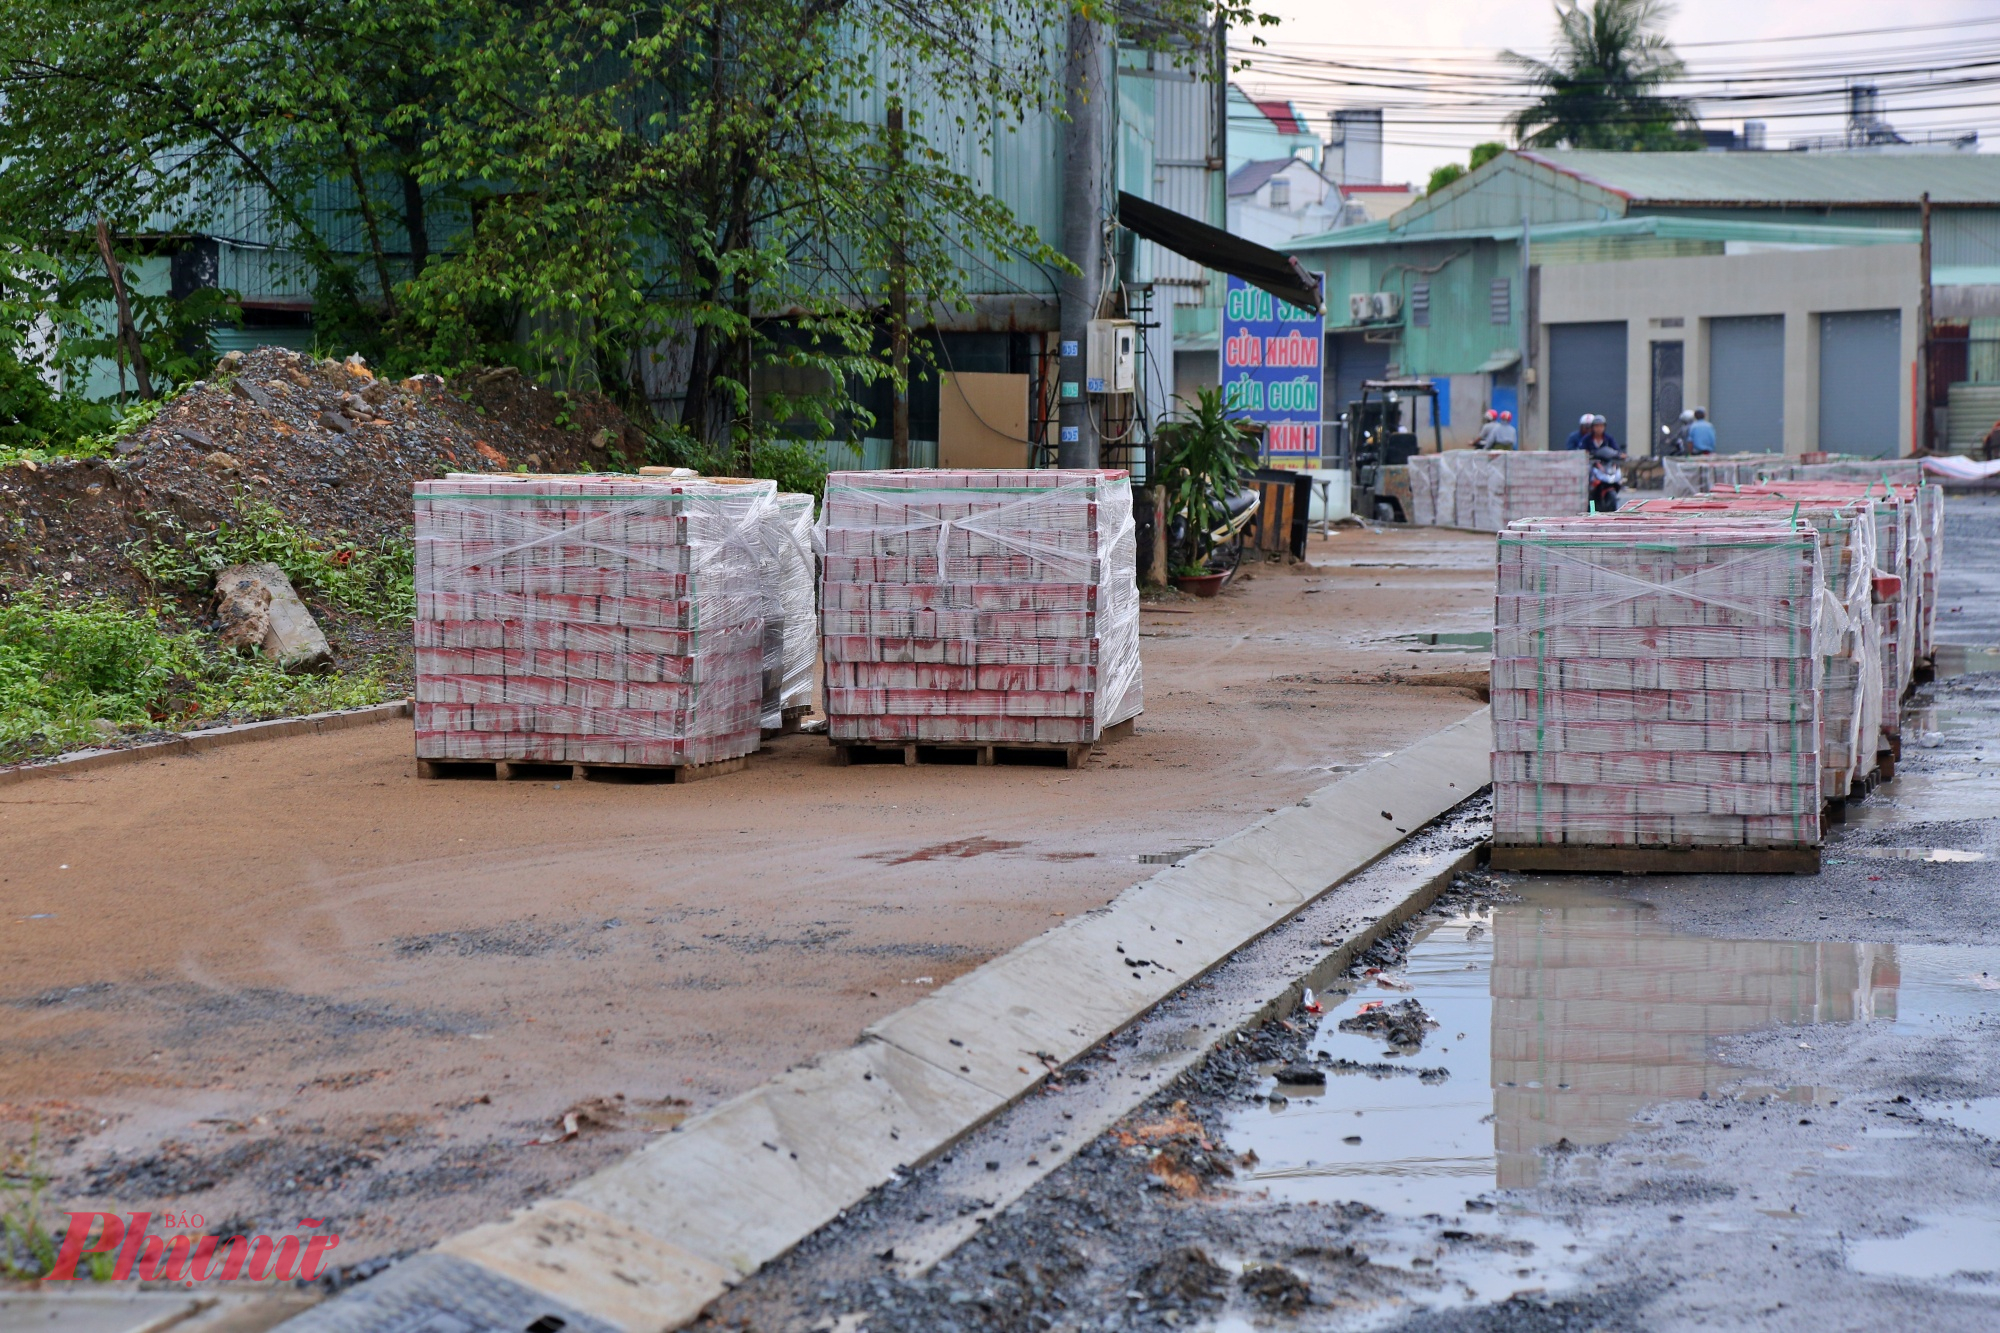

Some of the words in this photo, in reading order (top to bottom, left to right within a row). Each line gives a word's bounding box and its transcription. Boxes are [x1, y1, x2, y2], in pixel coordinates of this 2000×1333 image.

[1227, 328, 1262, 367] CỬA
[1266, 330, 1318, 367] NHÔM
[1269, 376, 1318, 411] CUỐN
